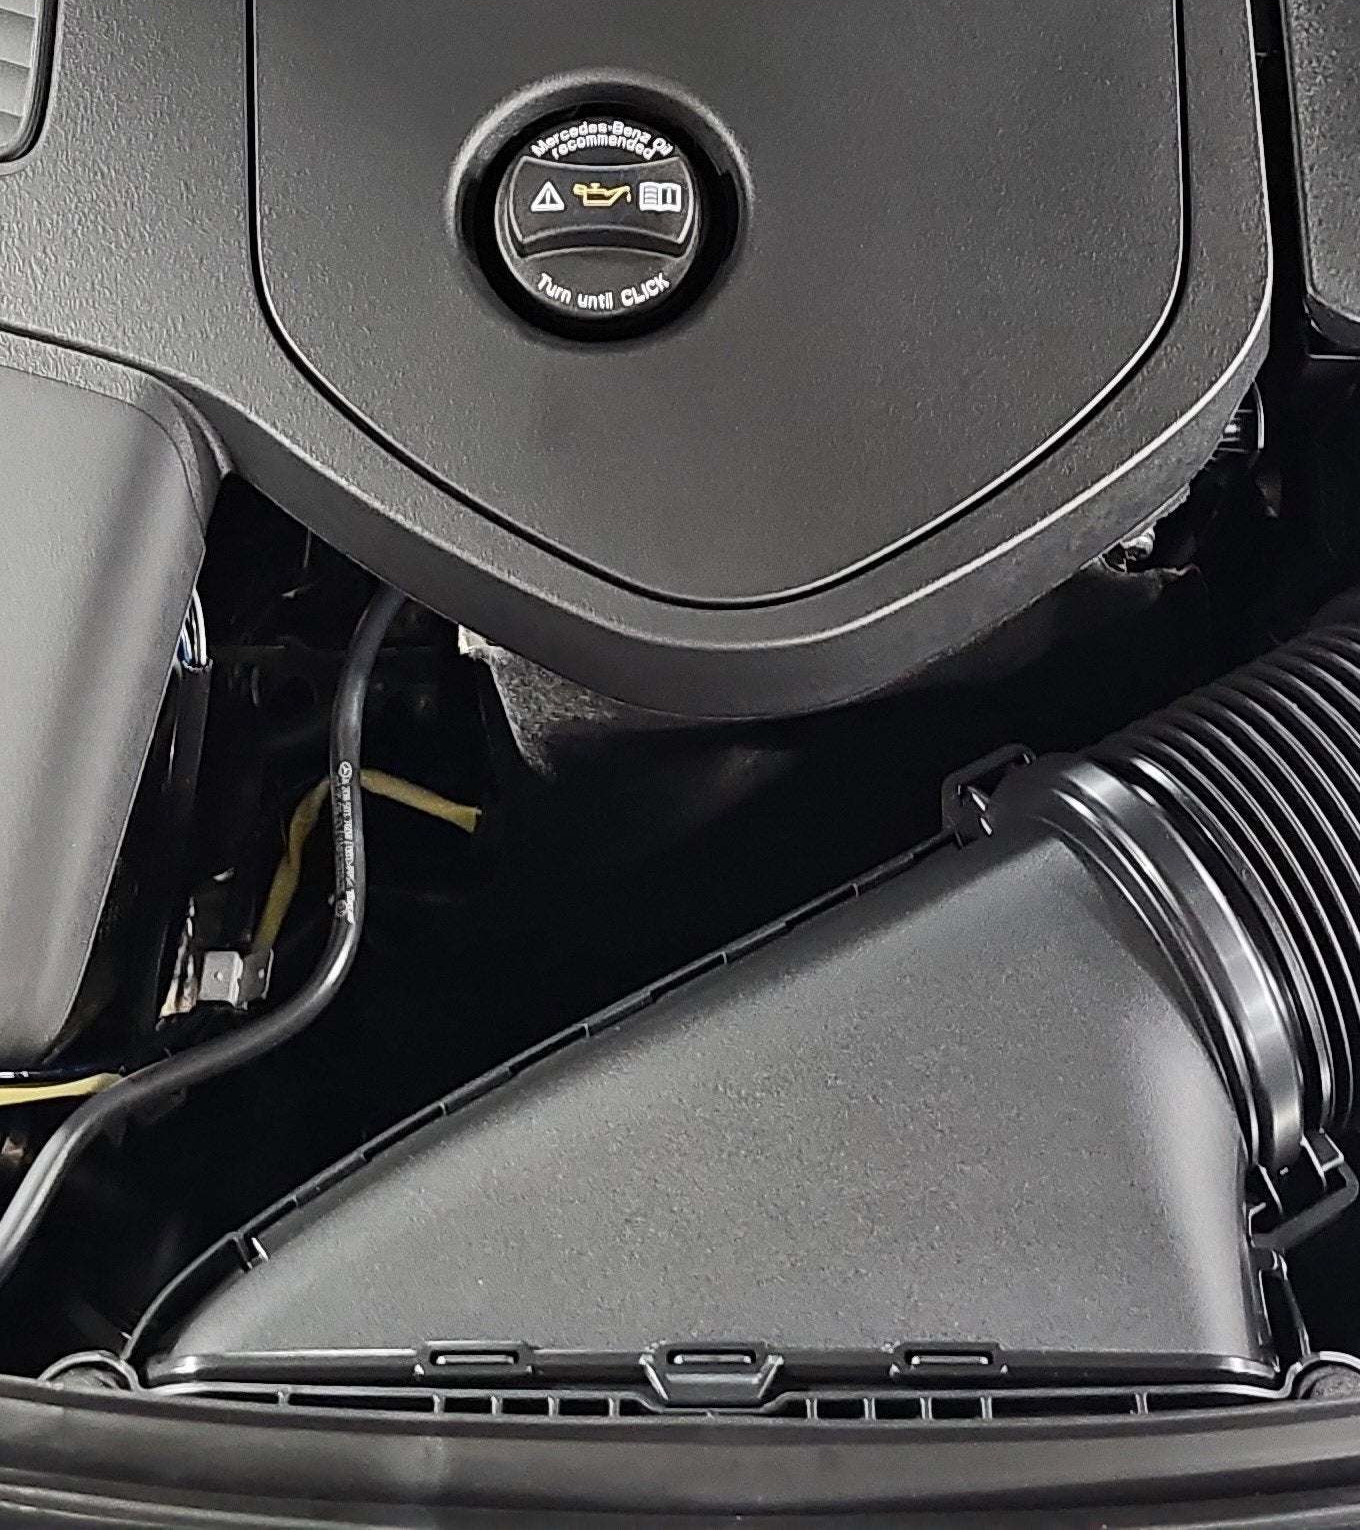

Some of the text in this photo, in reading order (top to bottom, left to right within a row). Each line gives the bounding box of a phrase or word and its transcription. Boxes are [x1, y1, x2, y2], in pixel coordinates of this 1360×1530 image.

[531, 121, 673, 157] Mercedes-Benz Oil
[552, 134, 656, 160] recommended
[538, 272, 670, 310] Turn until CLICK
